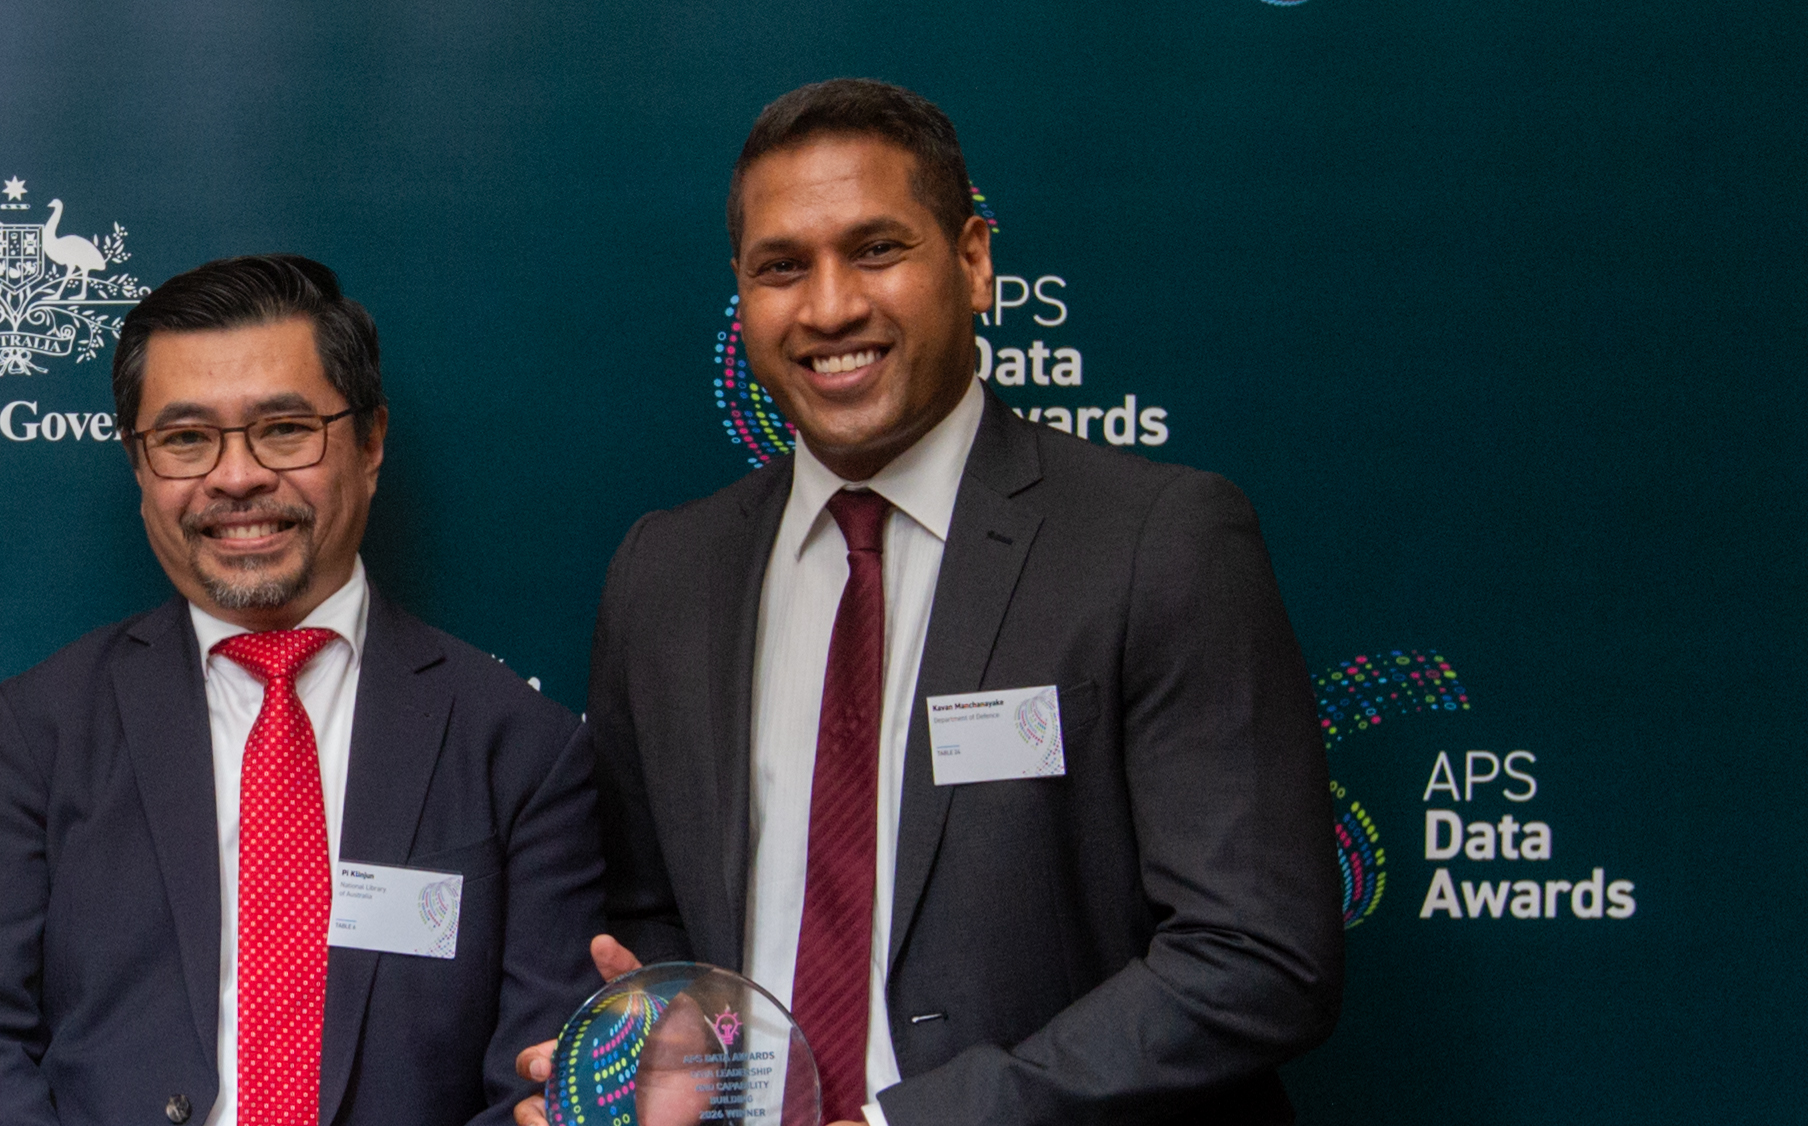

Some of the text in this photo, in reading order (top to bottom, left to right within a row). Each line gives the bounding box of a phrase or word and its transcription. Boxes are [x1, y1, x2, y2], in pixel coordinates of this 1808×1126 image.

[981, 275, 1067, 326] PS
[1012, 394, 1168, 445] ards
[1422, 750, 1537, 802] APS
[1425, 809, 1552, 861] Data
[1419, 867, 1636, 919] Awards
[716, 1067, 773, 1078] LEADERSHIP
[732, 1051, 776, 1062] AWARDS
[699, 1108, 766, 1120] 2026 WINNER
